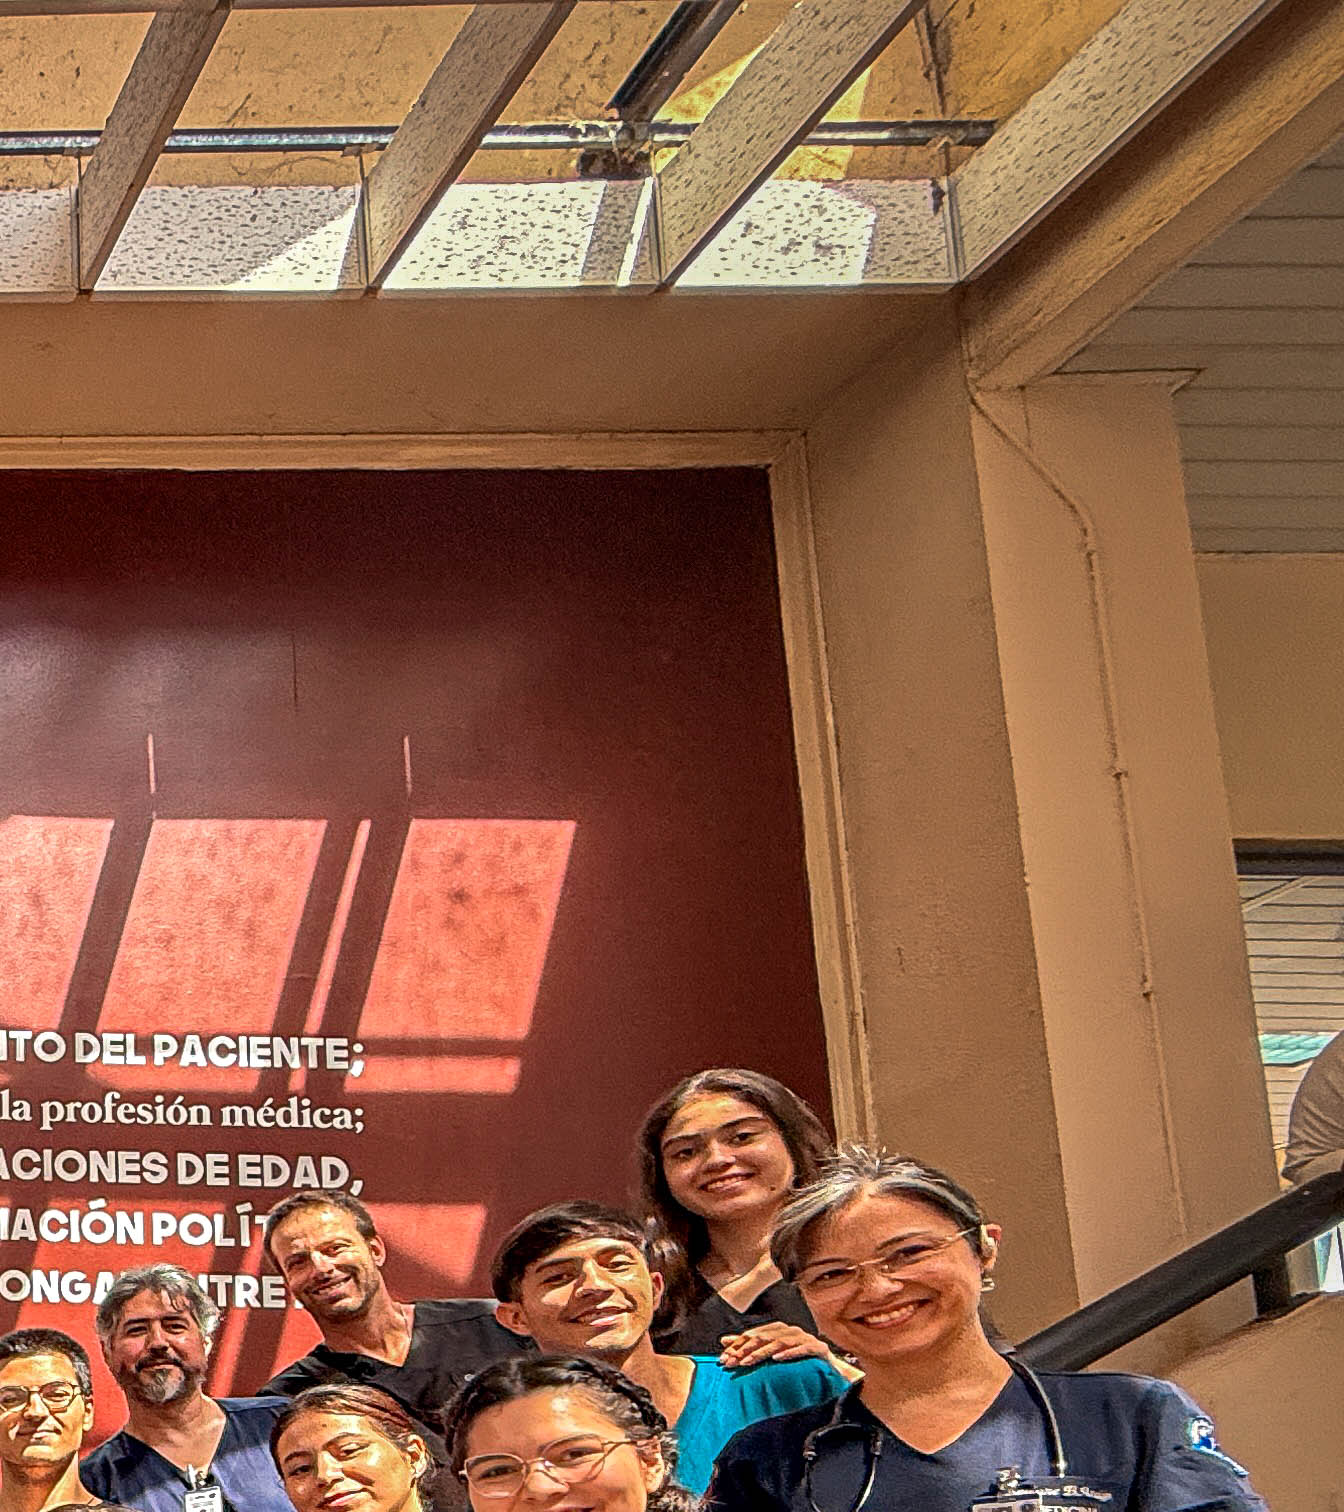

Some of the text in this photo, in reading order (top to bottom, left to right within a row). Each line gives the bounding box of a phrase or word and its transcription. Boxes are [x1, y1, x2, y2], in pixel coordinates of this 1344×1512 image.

[74, 1032, 147, 1066] DEL
[153, 1033, 367, 1081] PACIENTE;
[0, 1088, 33, 1122] la
[39, 1091, 214, 1131] profesión
[220, 1095, 364, 1134] médica;
[177, 1152, 230, 1186] DE
[237, 1153, 364, 1198] EDAD,
[151, 1202, 274, 1249] POLÍ
